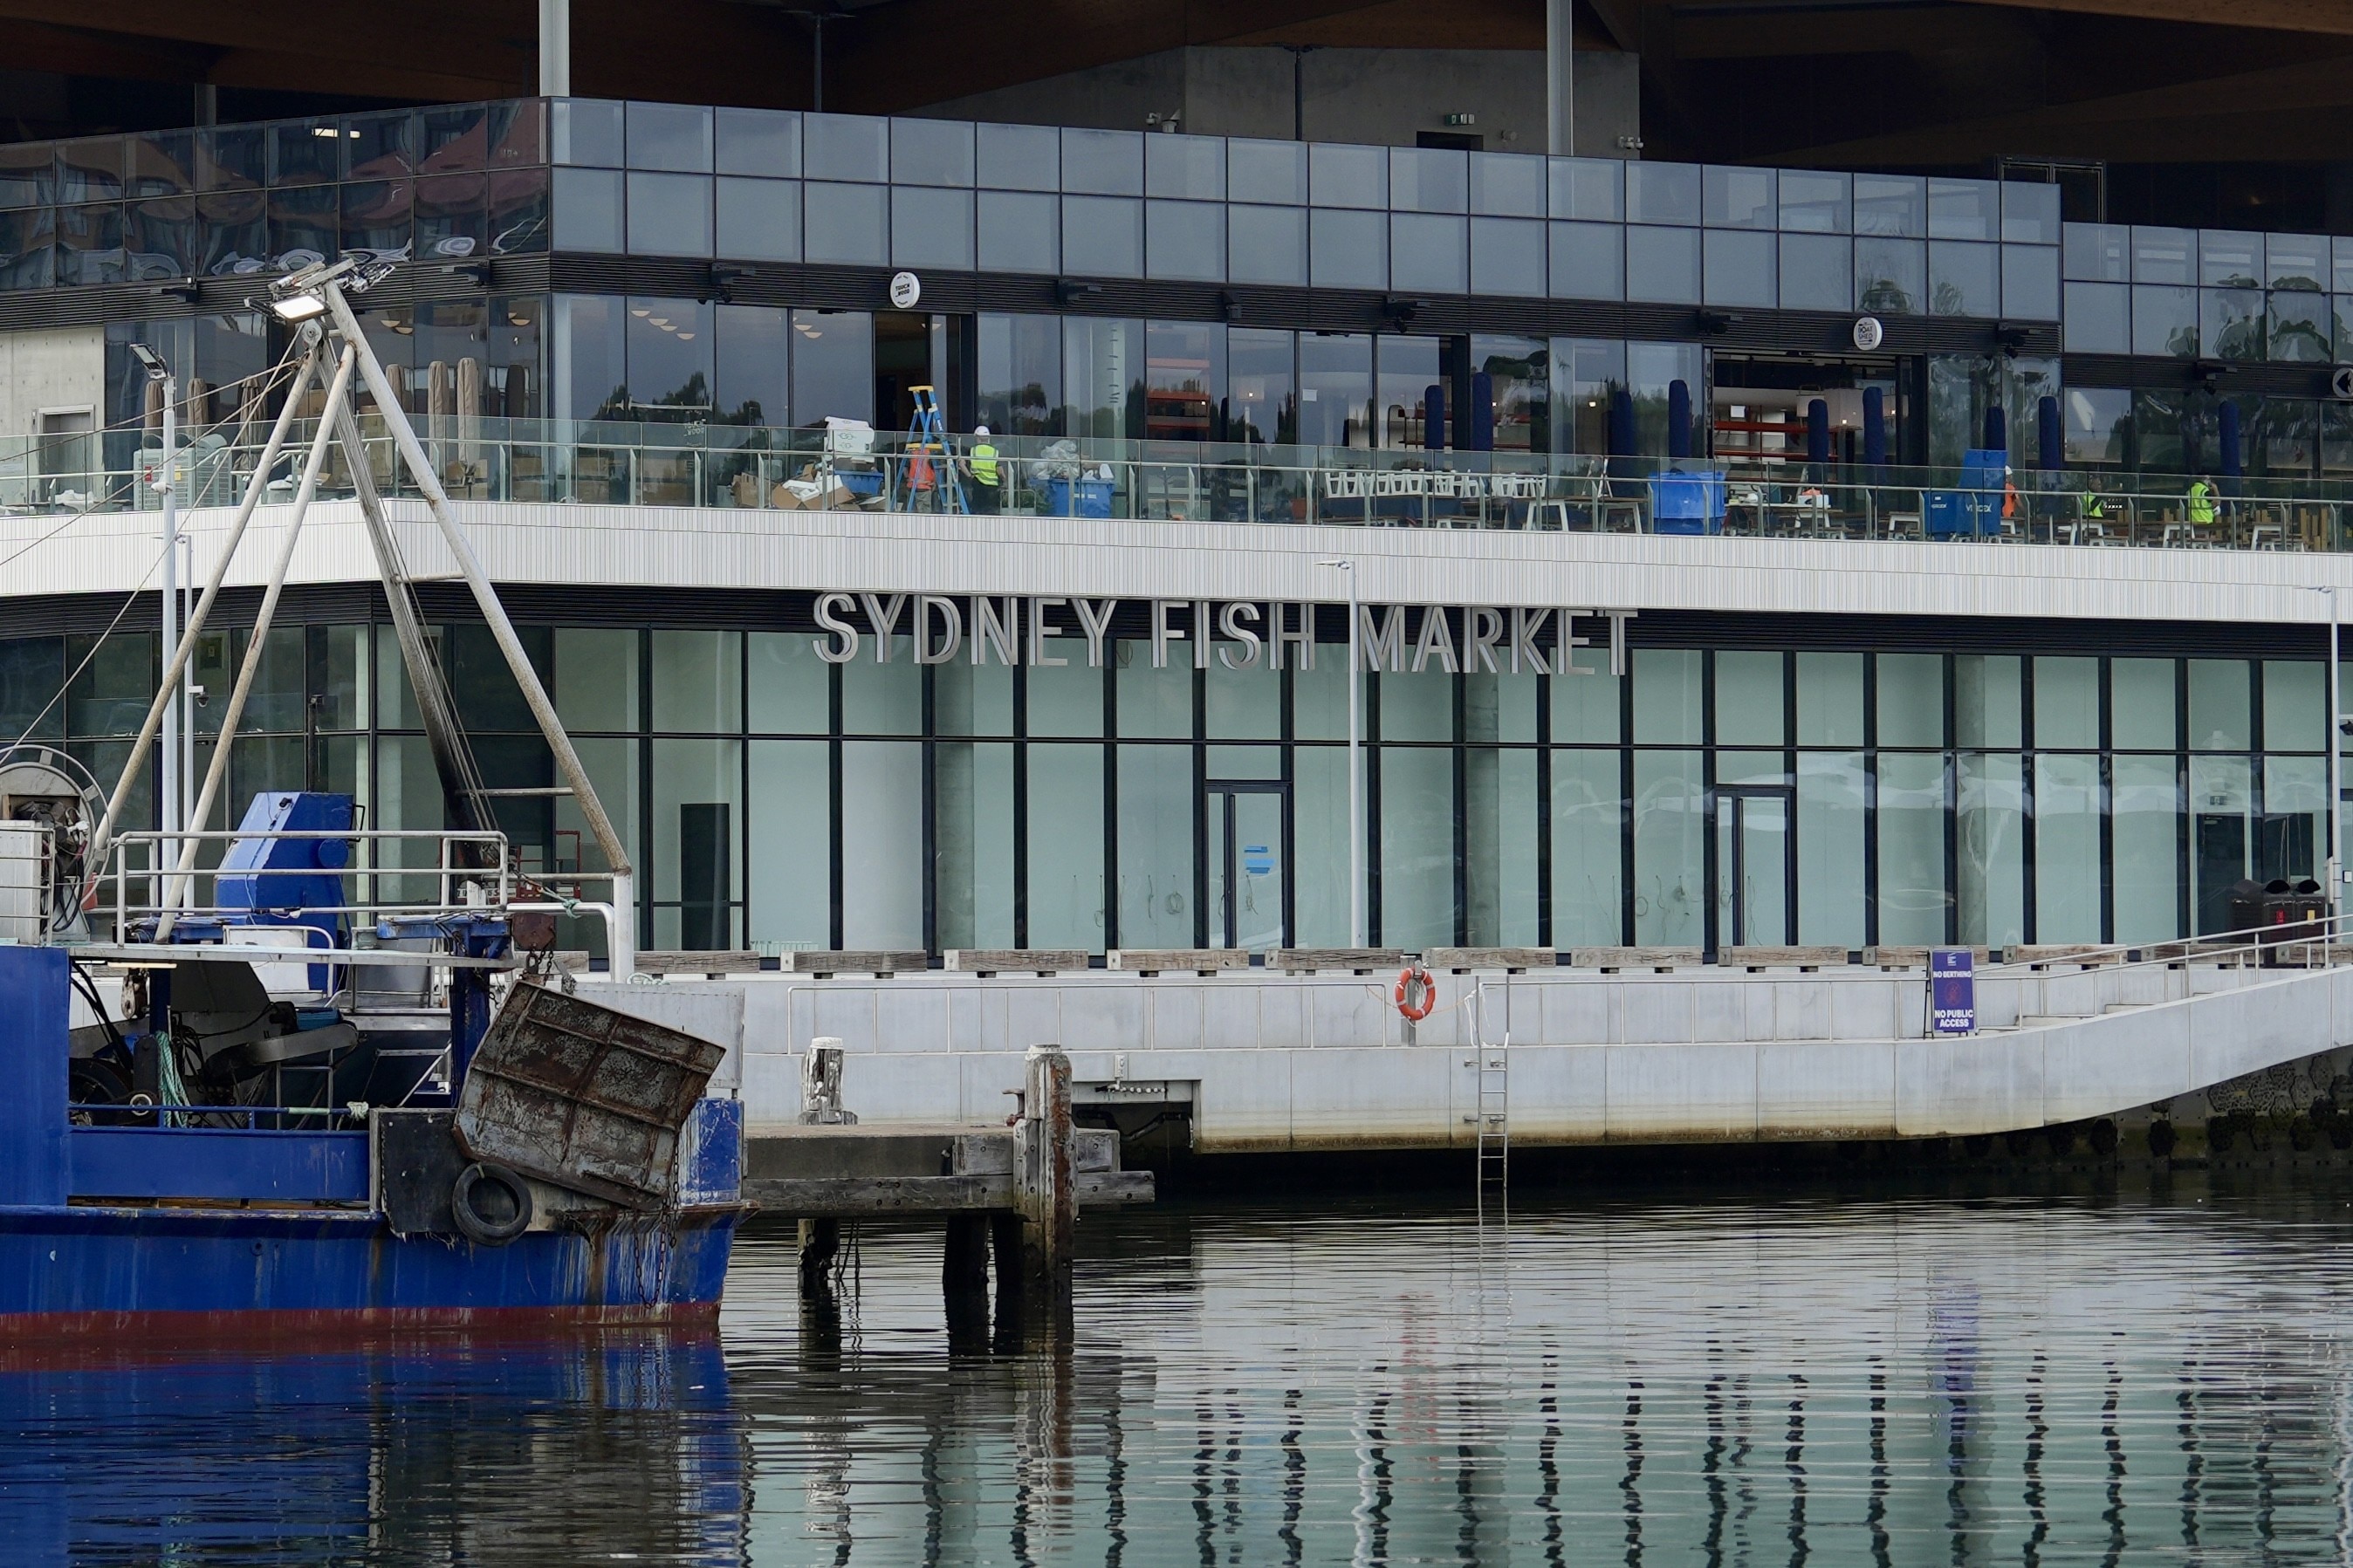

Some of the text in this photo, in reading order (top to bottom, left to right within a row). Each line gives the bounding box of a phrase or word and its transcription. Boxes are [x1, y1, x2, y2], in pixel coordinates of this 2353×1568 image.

[812, 592, 1638, 675] SYDNEY FISH MARKET
[1934, 1009, 1973, 1018] NO PUBLIC
[1939, 1018, 1969, 1028] ACCESS
